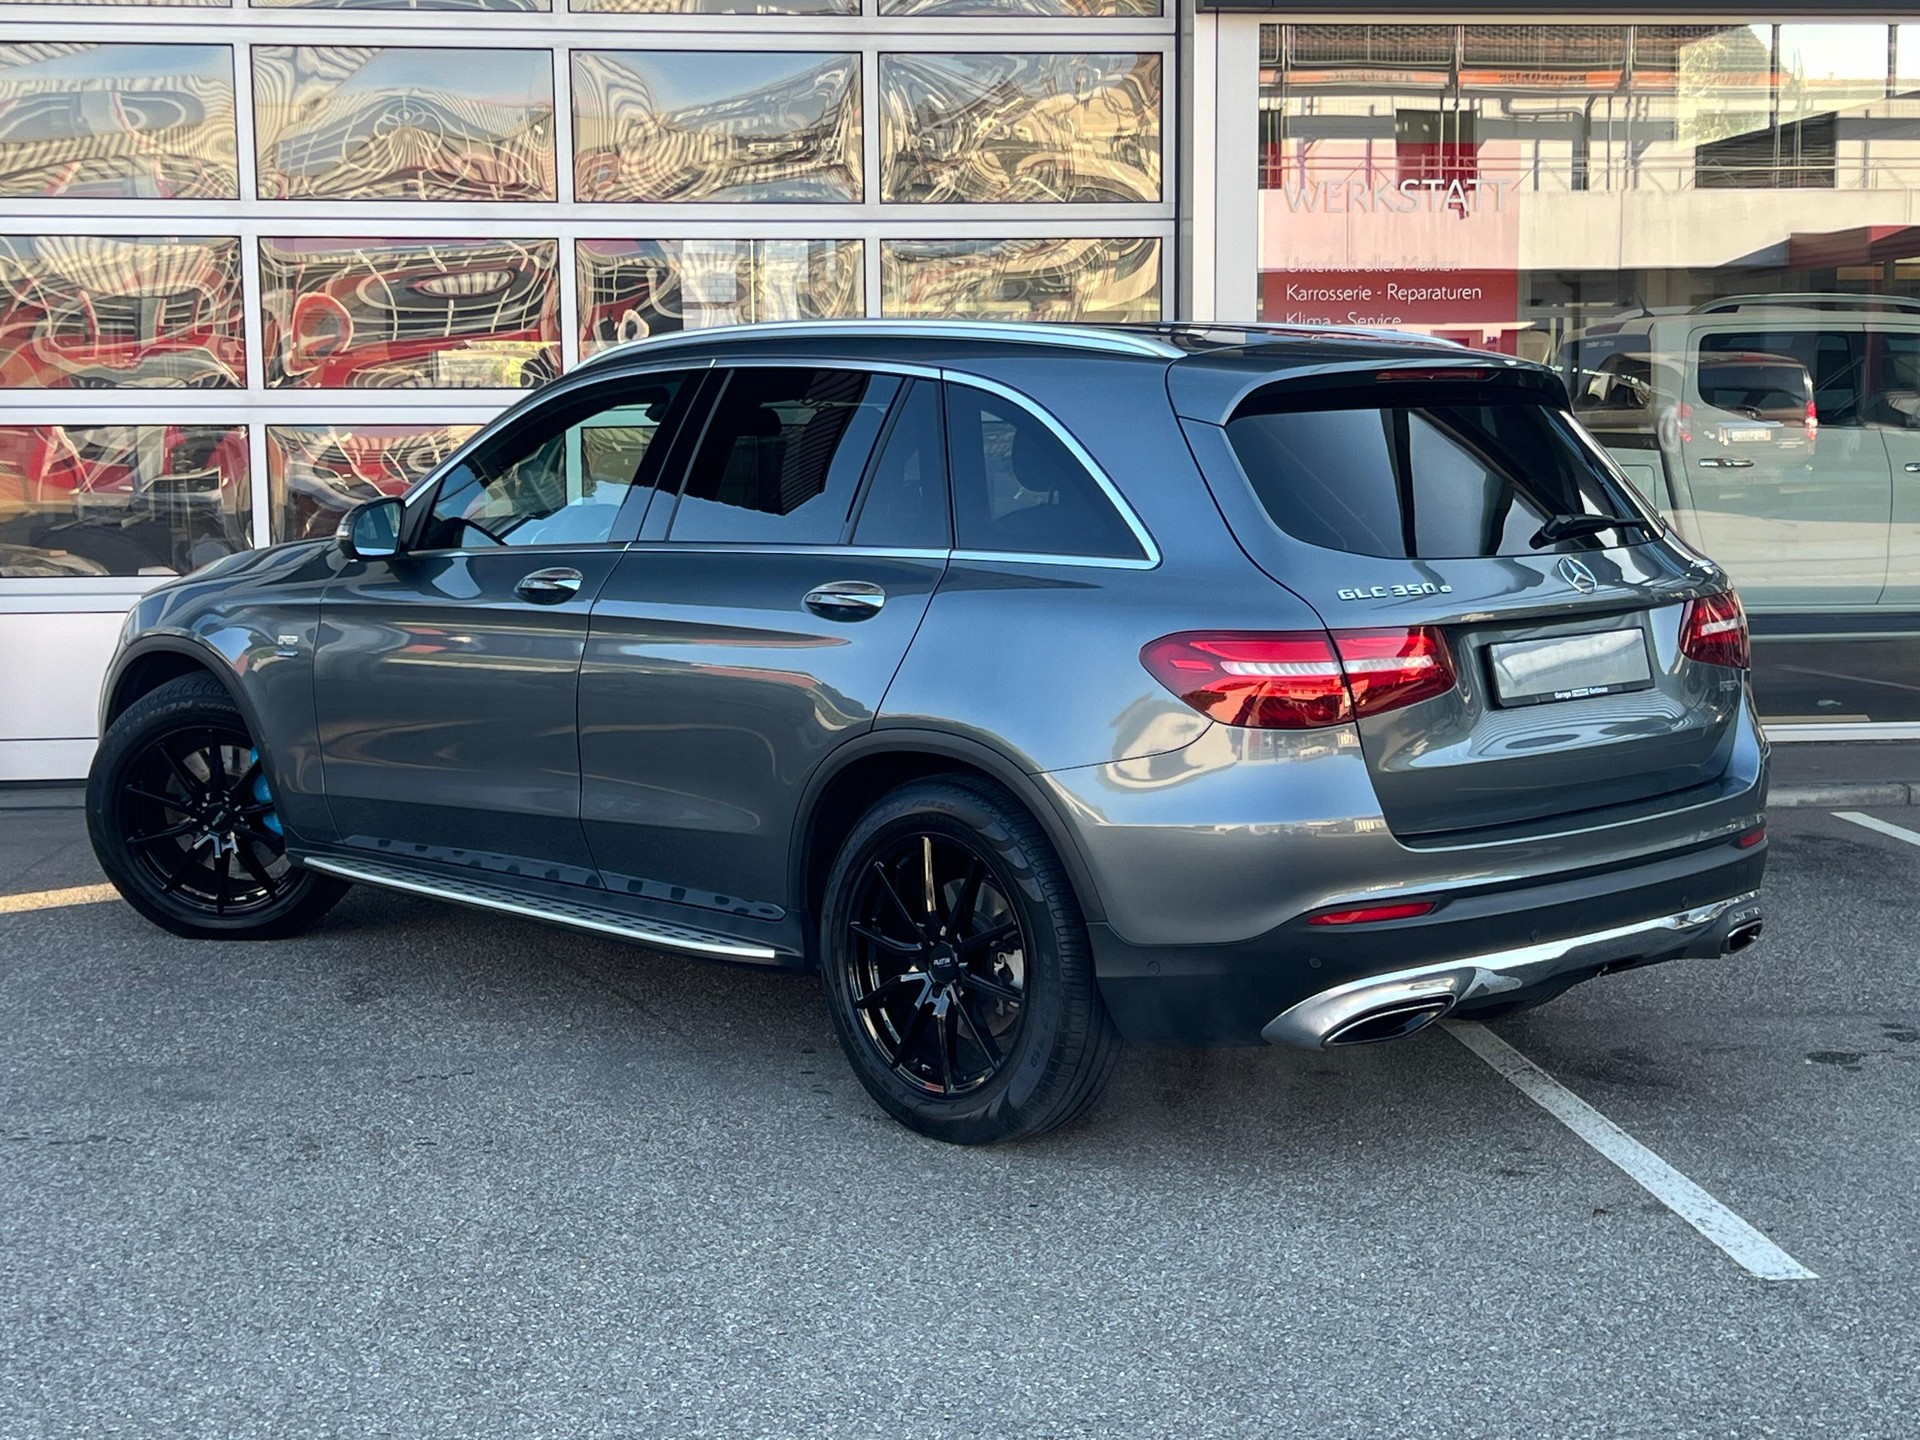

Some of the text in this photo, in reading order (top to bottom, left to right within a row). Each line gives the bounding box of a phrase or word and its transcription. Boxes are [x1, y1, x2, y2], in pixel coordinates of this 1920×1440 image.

[1284, 178, 1509, 213] WERKSTATT
[1286, 284, 1372, 301] Karrosserie
[1387, 283, 1482, 305] Reparaturen
[1286, 311, 1331, 325] Klima
[1347, 311, 1402, 326] Service
[1337, 586, 1388, 600] GLC
